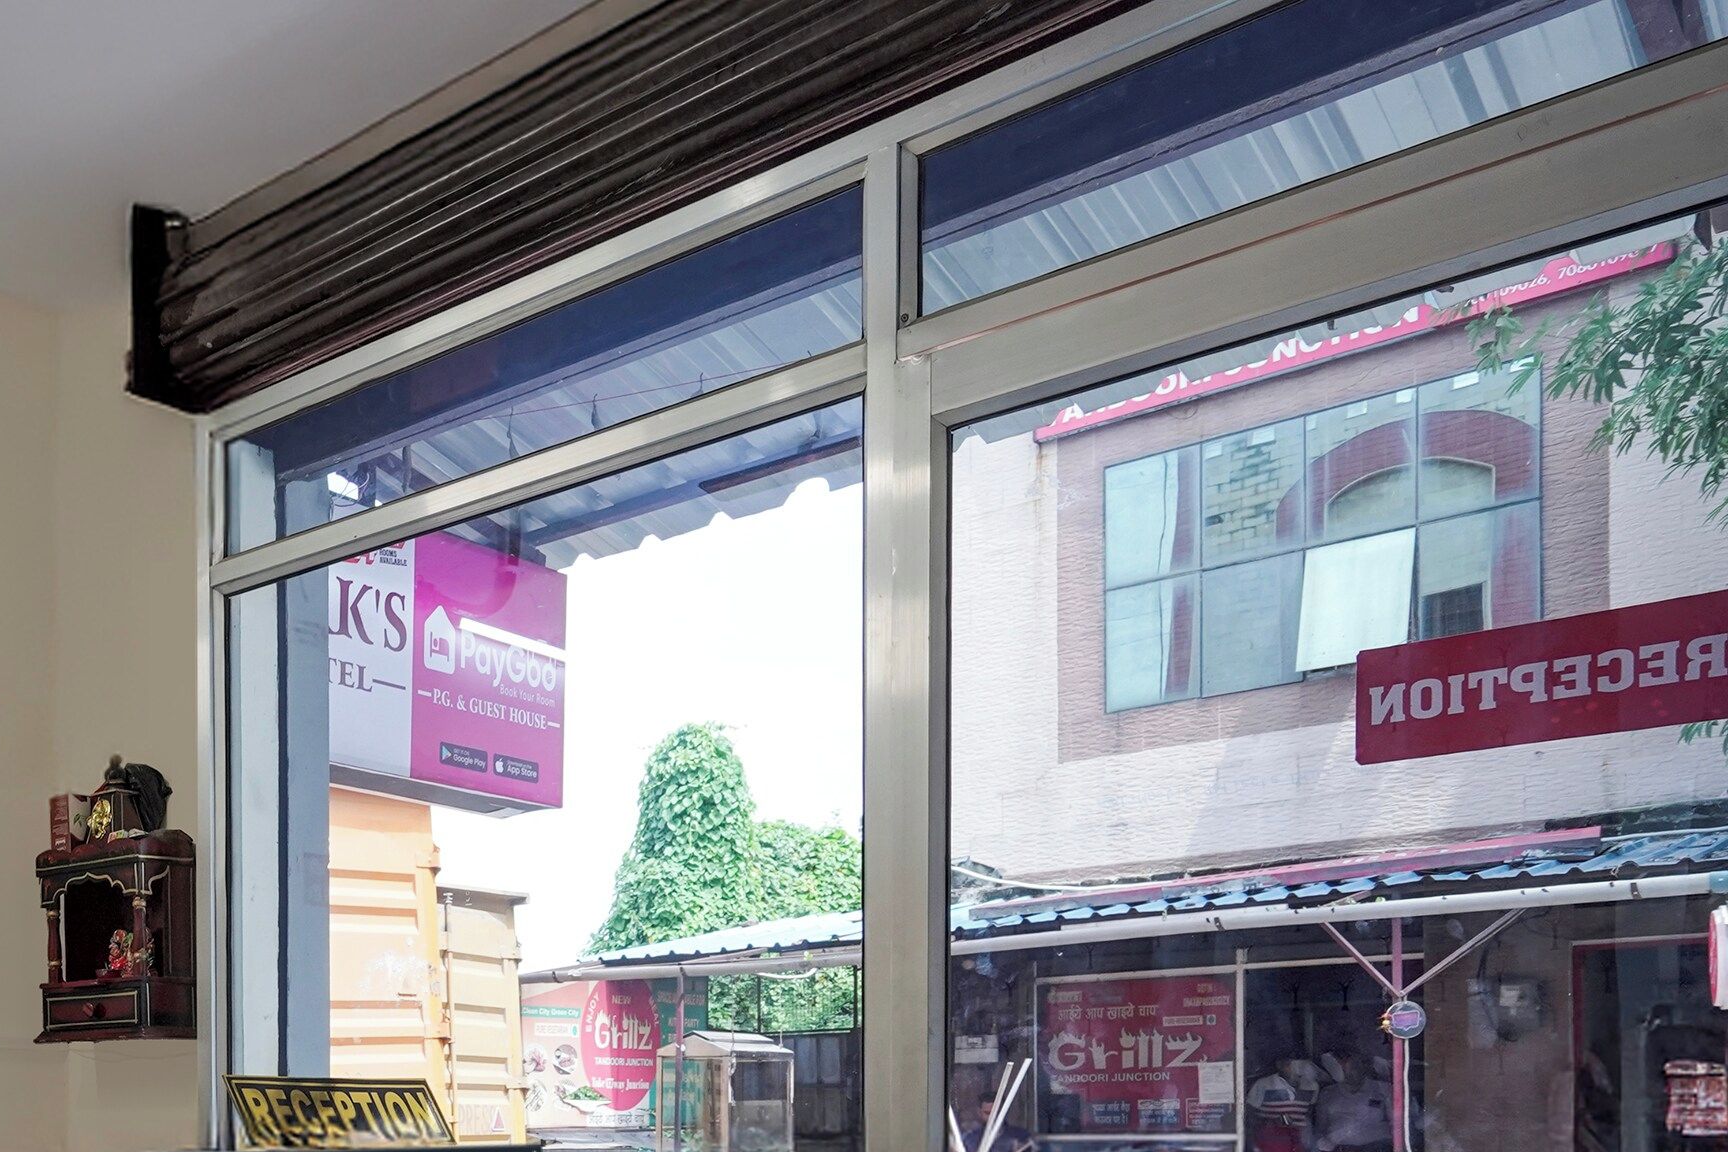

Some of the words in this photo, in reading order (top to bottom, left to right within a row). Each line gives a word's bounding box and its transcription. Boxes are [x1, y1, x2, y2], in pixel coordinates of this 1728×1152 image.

[379, 557, 407, 567] AVAILABLE
[329, 576, 407, 652] K'S
[500, 684, 518, 698] Book
[519, 689, 535, 703] Your
[537, 692, 556, 707] Room
[433, 687, 454, 709] P.G.
[457, 694, 467, 711] &
[469, 697, 507, 720] GUEST
[509, 704, 547, 730] HOUSE
[453, 754, 473, 766] Google
[473, 758, 486, 769] Play
[506, 766, 520, 776] App
[520, 768, 537, 778] Store
[611, 994, 632, 1005] NEW
[539, 1008, 550, 1016] City
[568, 1009, 579, 1018] City
[594, 1009, 653, 1050] Grillz
[1048, 1027, 1207, 1071] Grillz
[1052, 1073, 1108, 1083] ANDOORI
[1111, 1072, 1170, 1082] JUNCTION
[241, 1088, 443, 1143] RECEPTION
